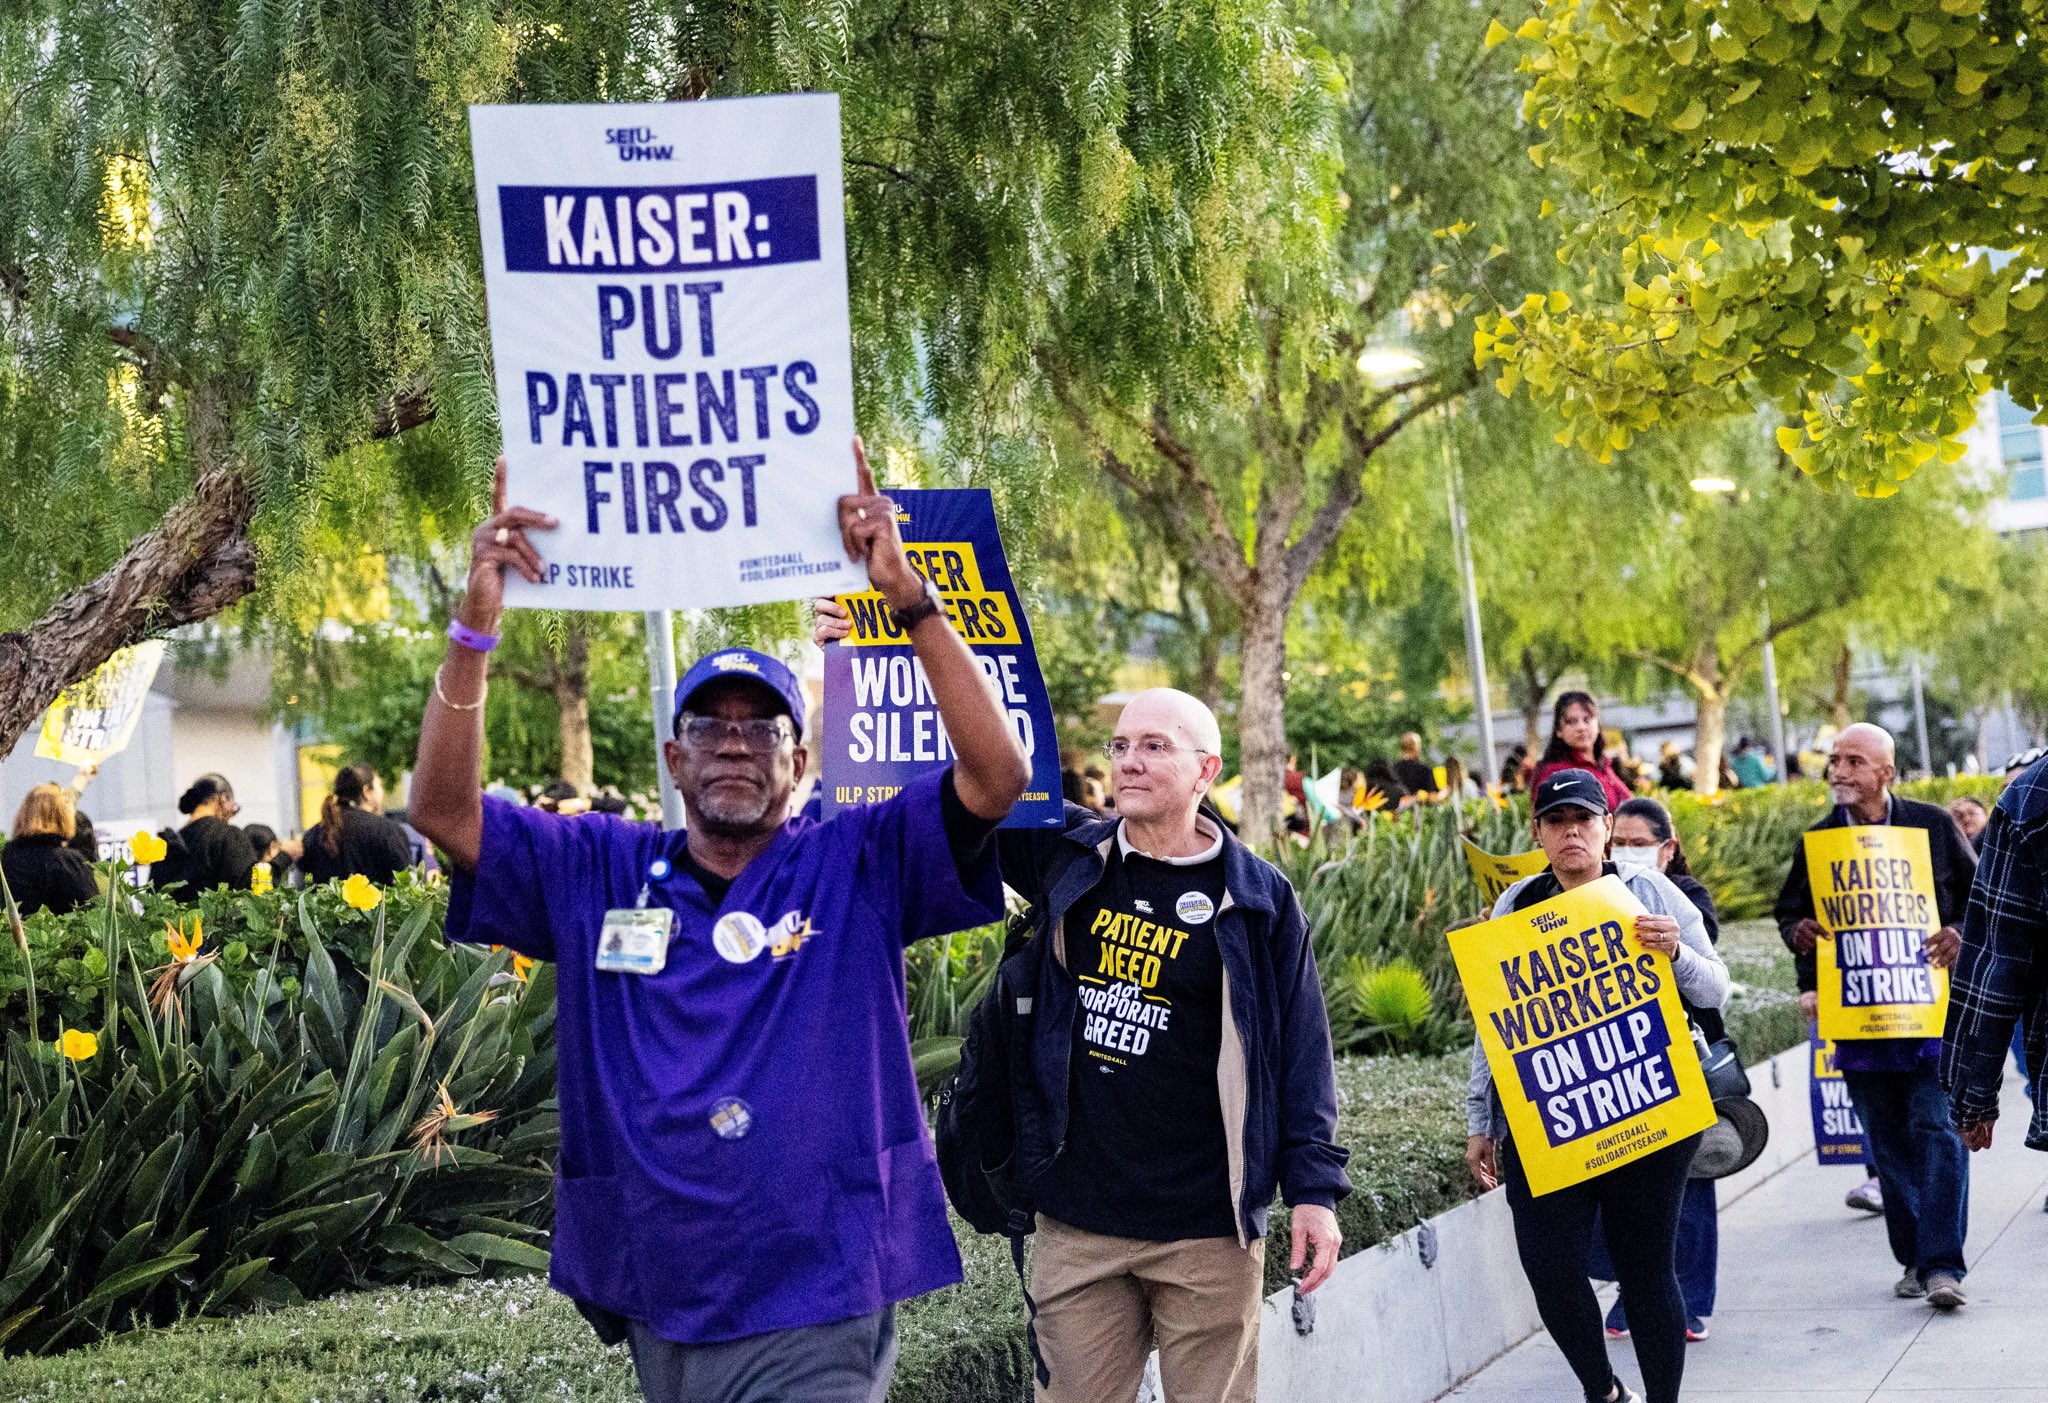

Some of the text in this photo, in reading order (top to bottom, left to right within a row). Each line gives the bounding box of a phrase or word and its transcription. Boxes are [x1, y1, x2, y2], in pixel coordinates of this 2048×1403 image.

[620, 145, 673, 161] UHW
[543, 191, 771, 267] KAISER:
[597, 281, 724, 361] PUT
[525, 360, 821, 448] PATIENTS
[583, 453, 766, 535] FIRST
[567, 564, 635, 588] STRIKE
[906, 549, 971, 592] SER
[845, 598, 1007, 640] WOERS
[848, 708, 1035, 763] SILEND
[836, 786, 903, 803] ULP STRI
[1831, 858, 1913, 893] KAISER
[1530, 911, 1558, 928] SEIU-
[1540, 915, 1568, 934] UHW
[1821, 893, 1931, 928] WORKERS
[1090, 908, 1190, 960] PATIENT
[1842, 930, 1921, 970] ON ULP
[1098, 941, 1161, 989] NEED
[1500, 920, 1629, 1002] KAISER
[1078, 985, 1171, 1031] CORPORATE
[1106, 978, 1142, 999] not
[1489, 954, 1662, 1052] WORKERS
[1846, 967, 1932, 1006] STRIKE
[1083, 1012, 1151, 1056] GREED
[1531, 1010, 1653, 1094] ON ULP
[1547, 1054, 1673, 1140] STRIKE
[1585, 1128, 1669, 1171] #SOLIDARITYSEASON
[1596, 1122, 1650, 1152] #UNITED4ALL
